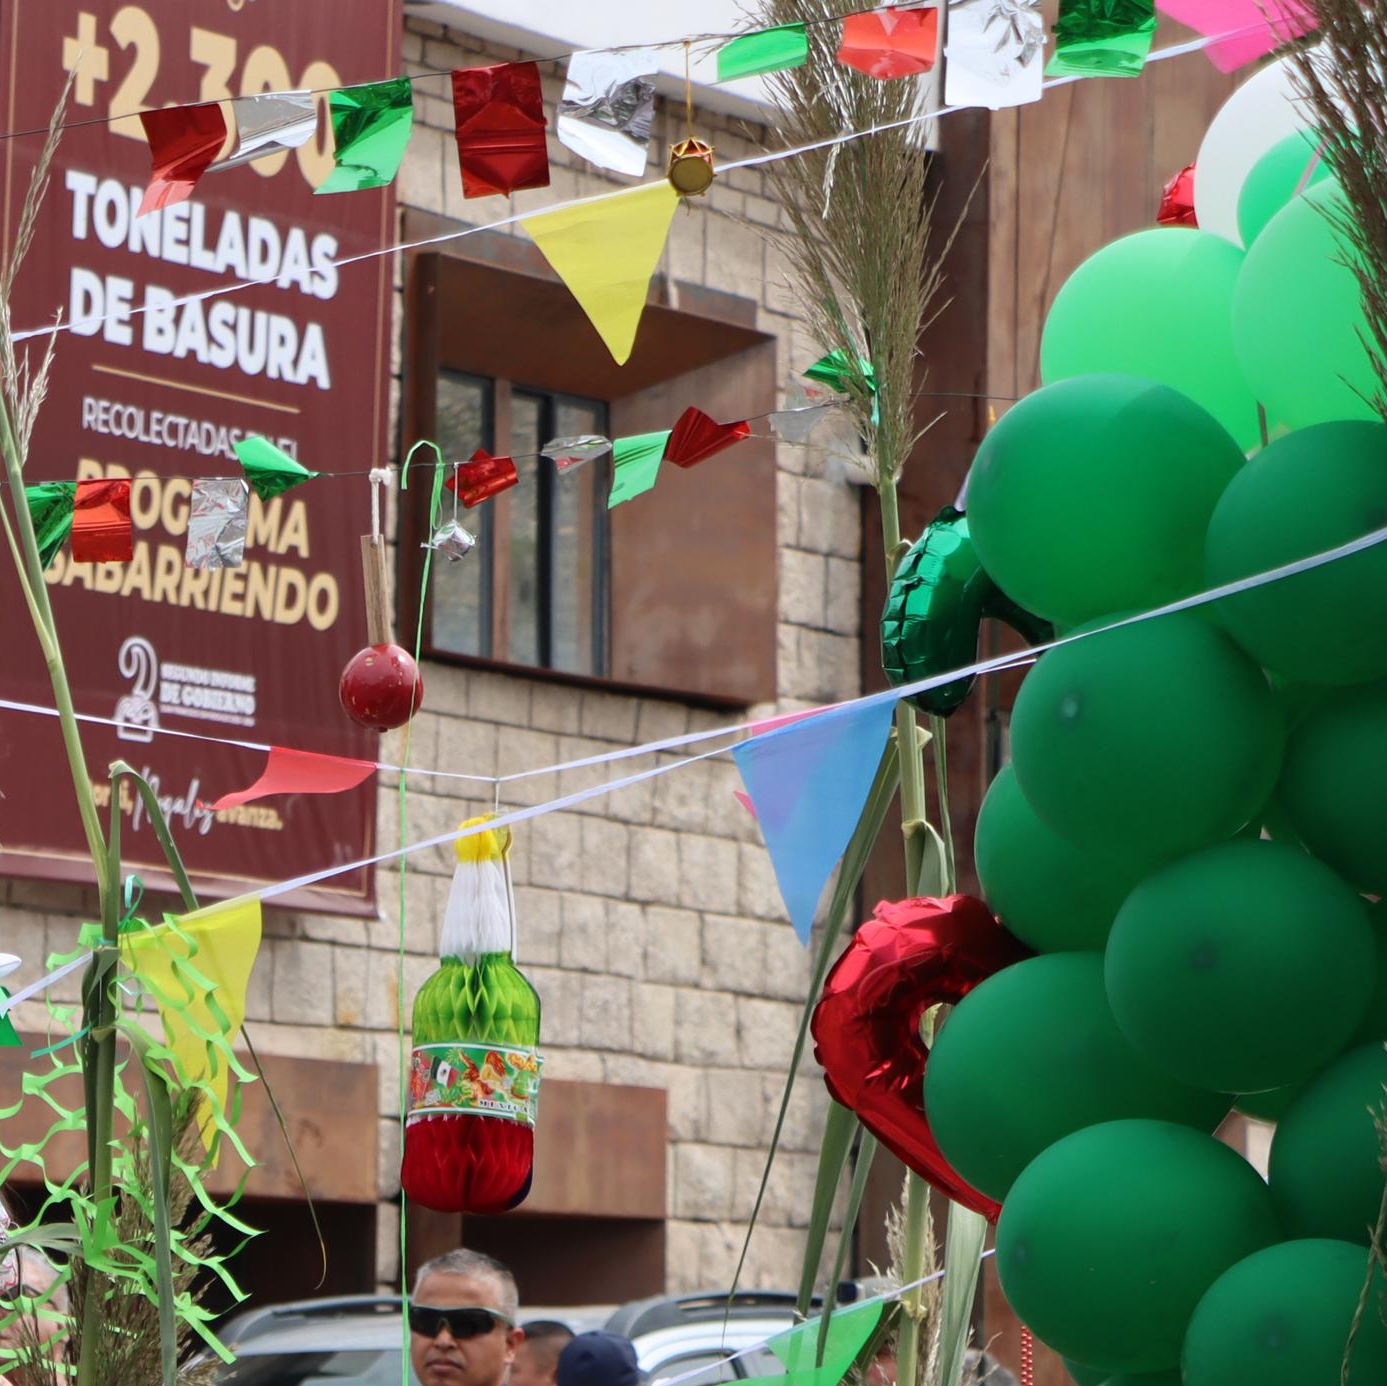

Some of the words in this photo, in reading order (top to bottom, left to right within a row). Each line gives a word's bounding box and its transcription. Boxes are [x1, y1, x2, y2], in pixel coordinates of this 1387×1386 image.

[65, 169, 340, 300] TONELADAS
[69, 267, 135, 347] DE
[143, 284, 332, 390] BASURA
[81, 396, 241, 461] RECOLECTADAS
